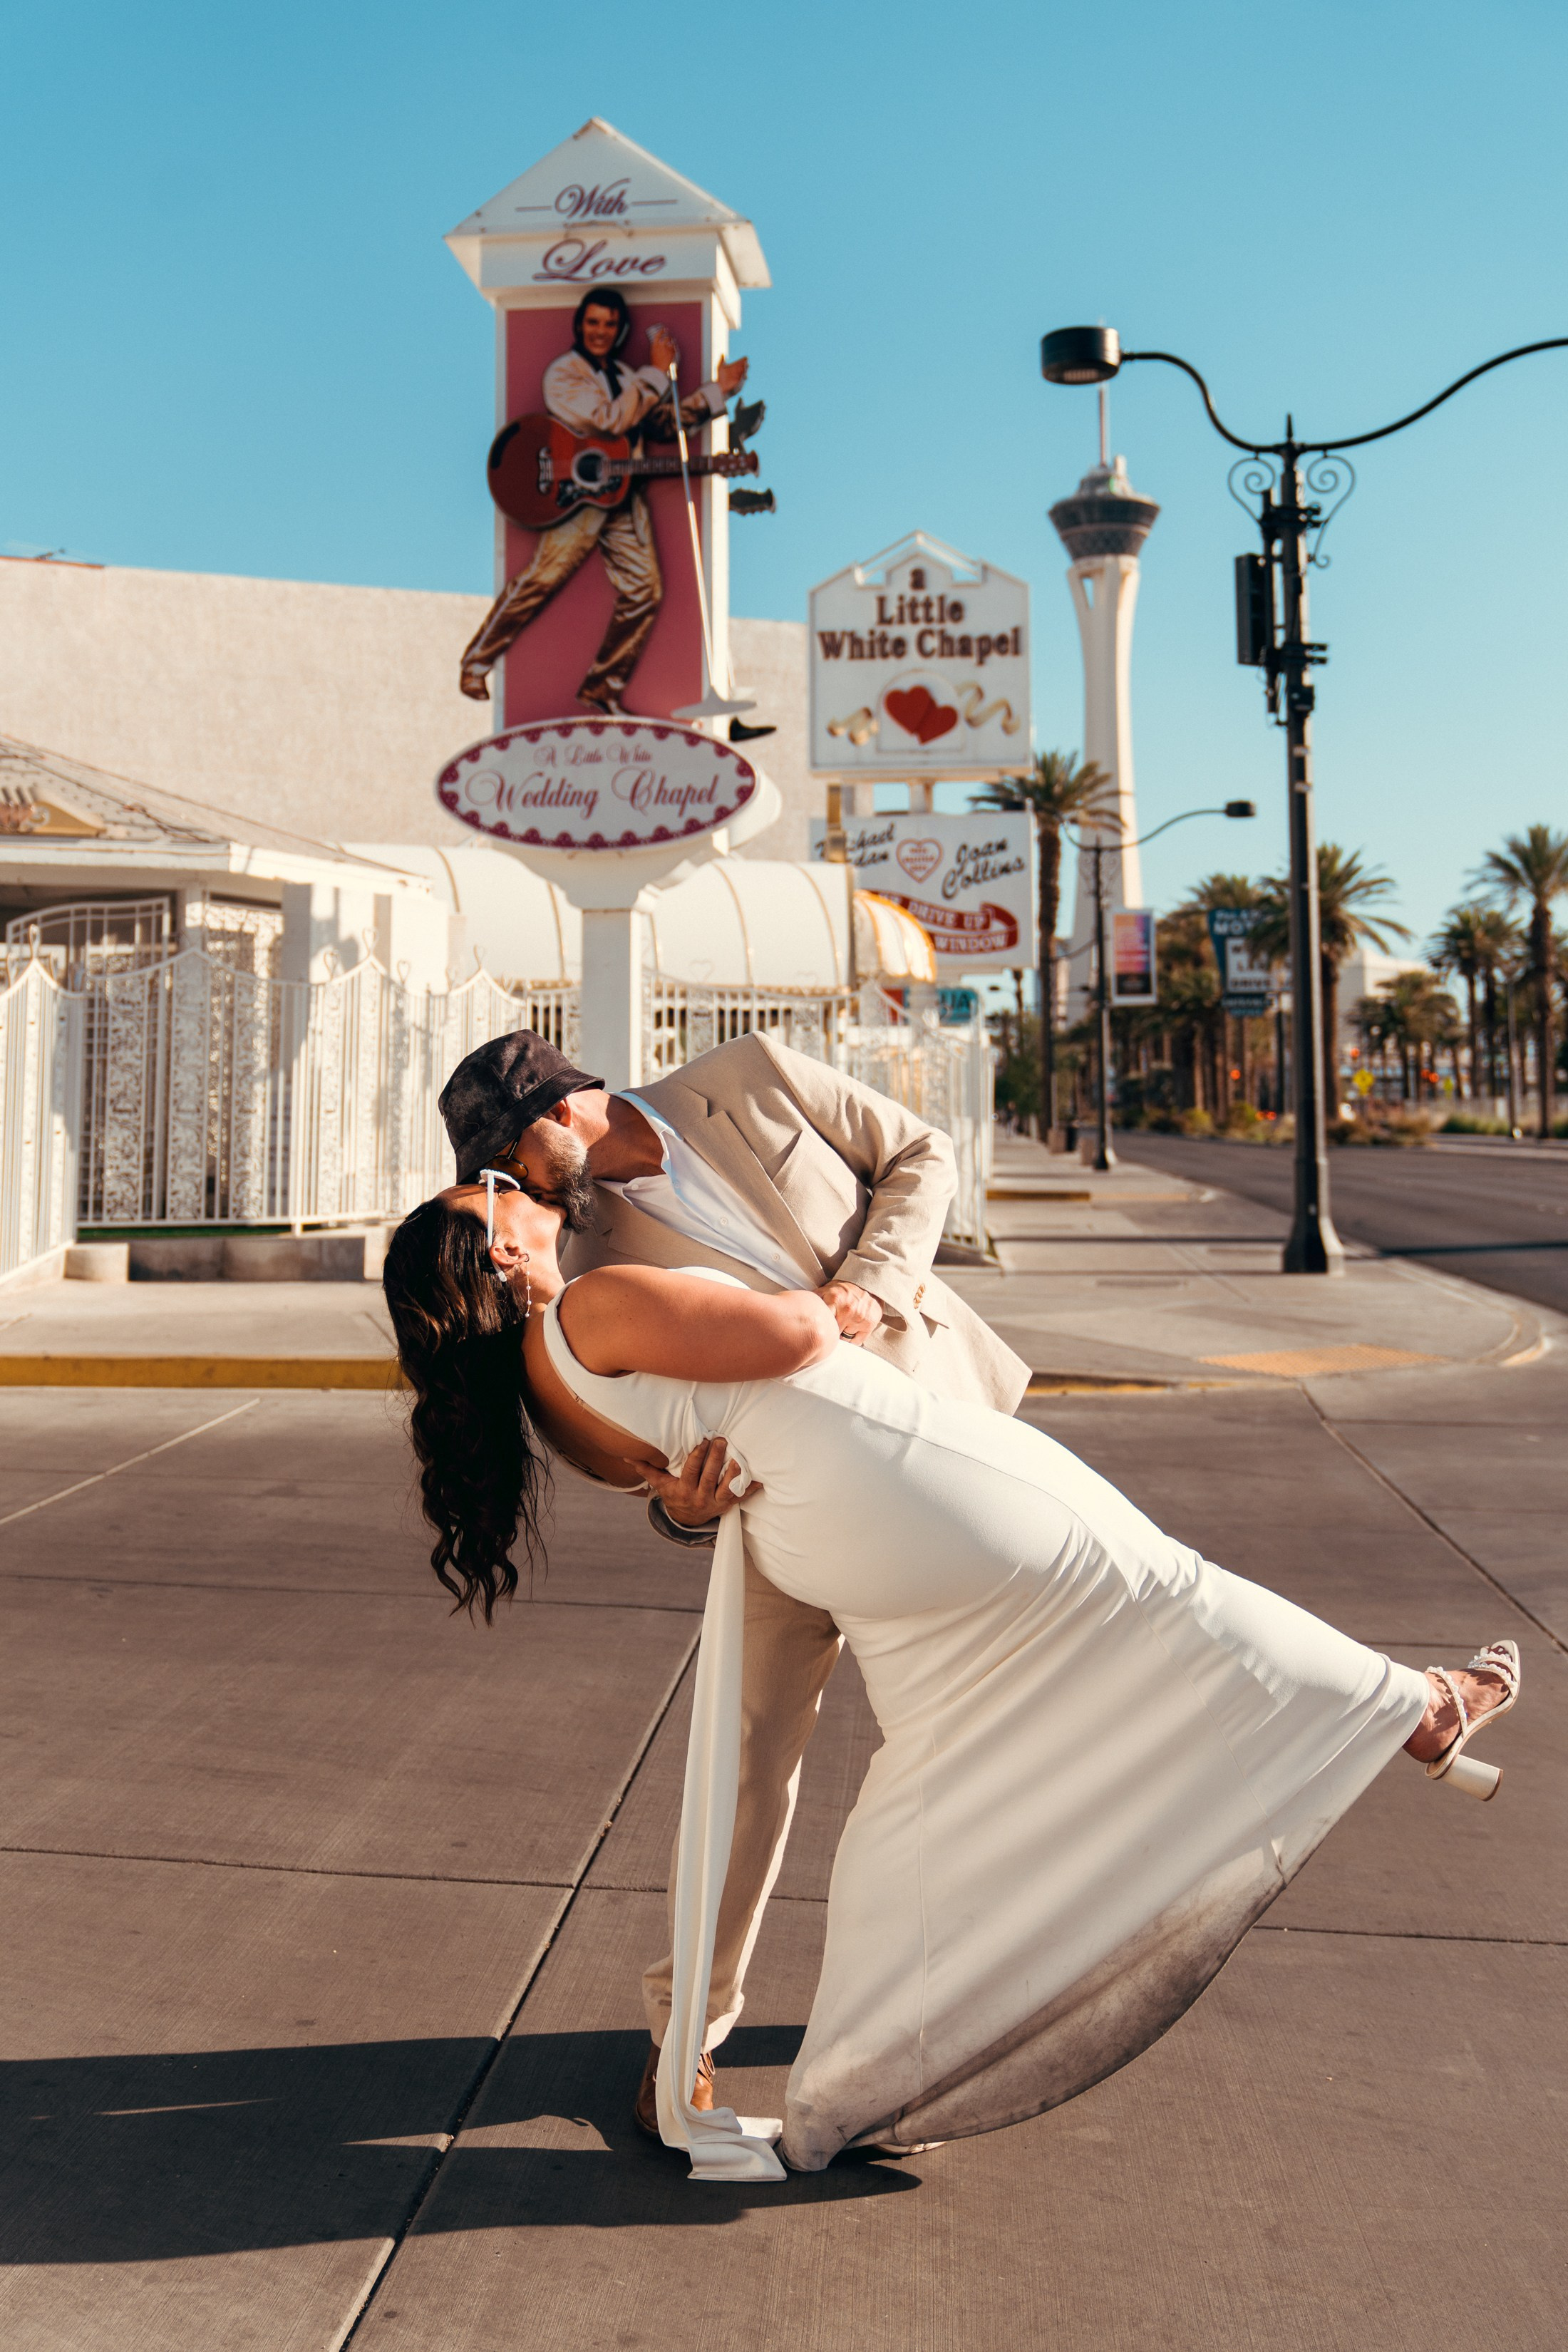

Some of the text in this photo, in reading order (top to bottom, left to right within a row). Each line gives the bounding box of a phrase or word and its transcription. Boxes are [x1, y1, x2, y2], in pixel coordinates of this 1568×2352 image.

[555, 178, 631, 218] With
[532, 238, 666, 282] Love
[909, 568, 925, 591] a
[876, 594, 965, 626] Little
[817, 624, 1022, 667] White Chapel
[564, 743, 604, 766] Little
[607, 743, 653, 765] White
[465, 765, 720, 819] Wedding Chapel
[955, 837, 1009, 875] Joan
[942, 857, 1025, 899] Collins
[907, 899, 985, 929] DRIVE UP
[934, 934, 1006, 950] WINDOW
